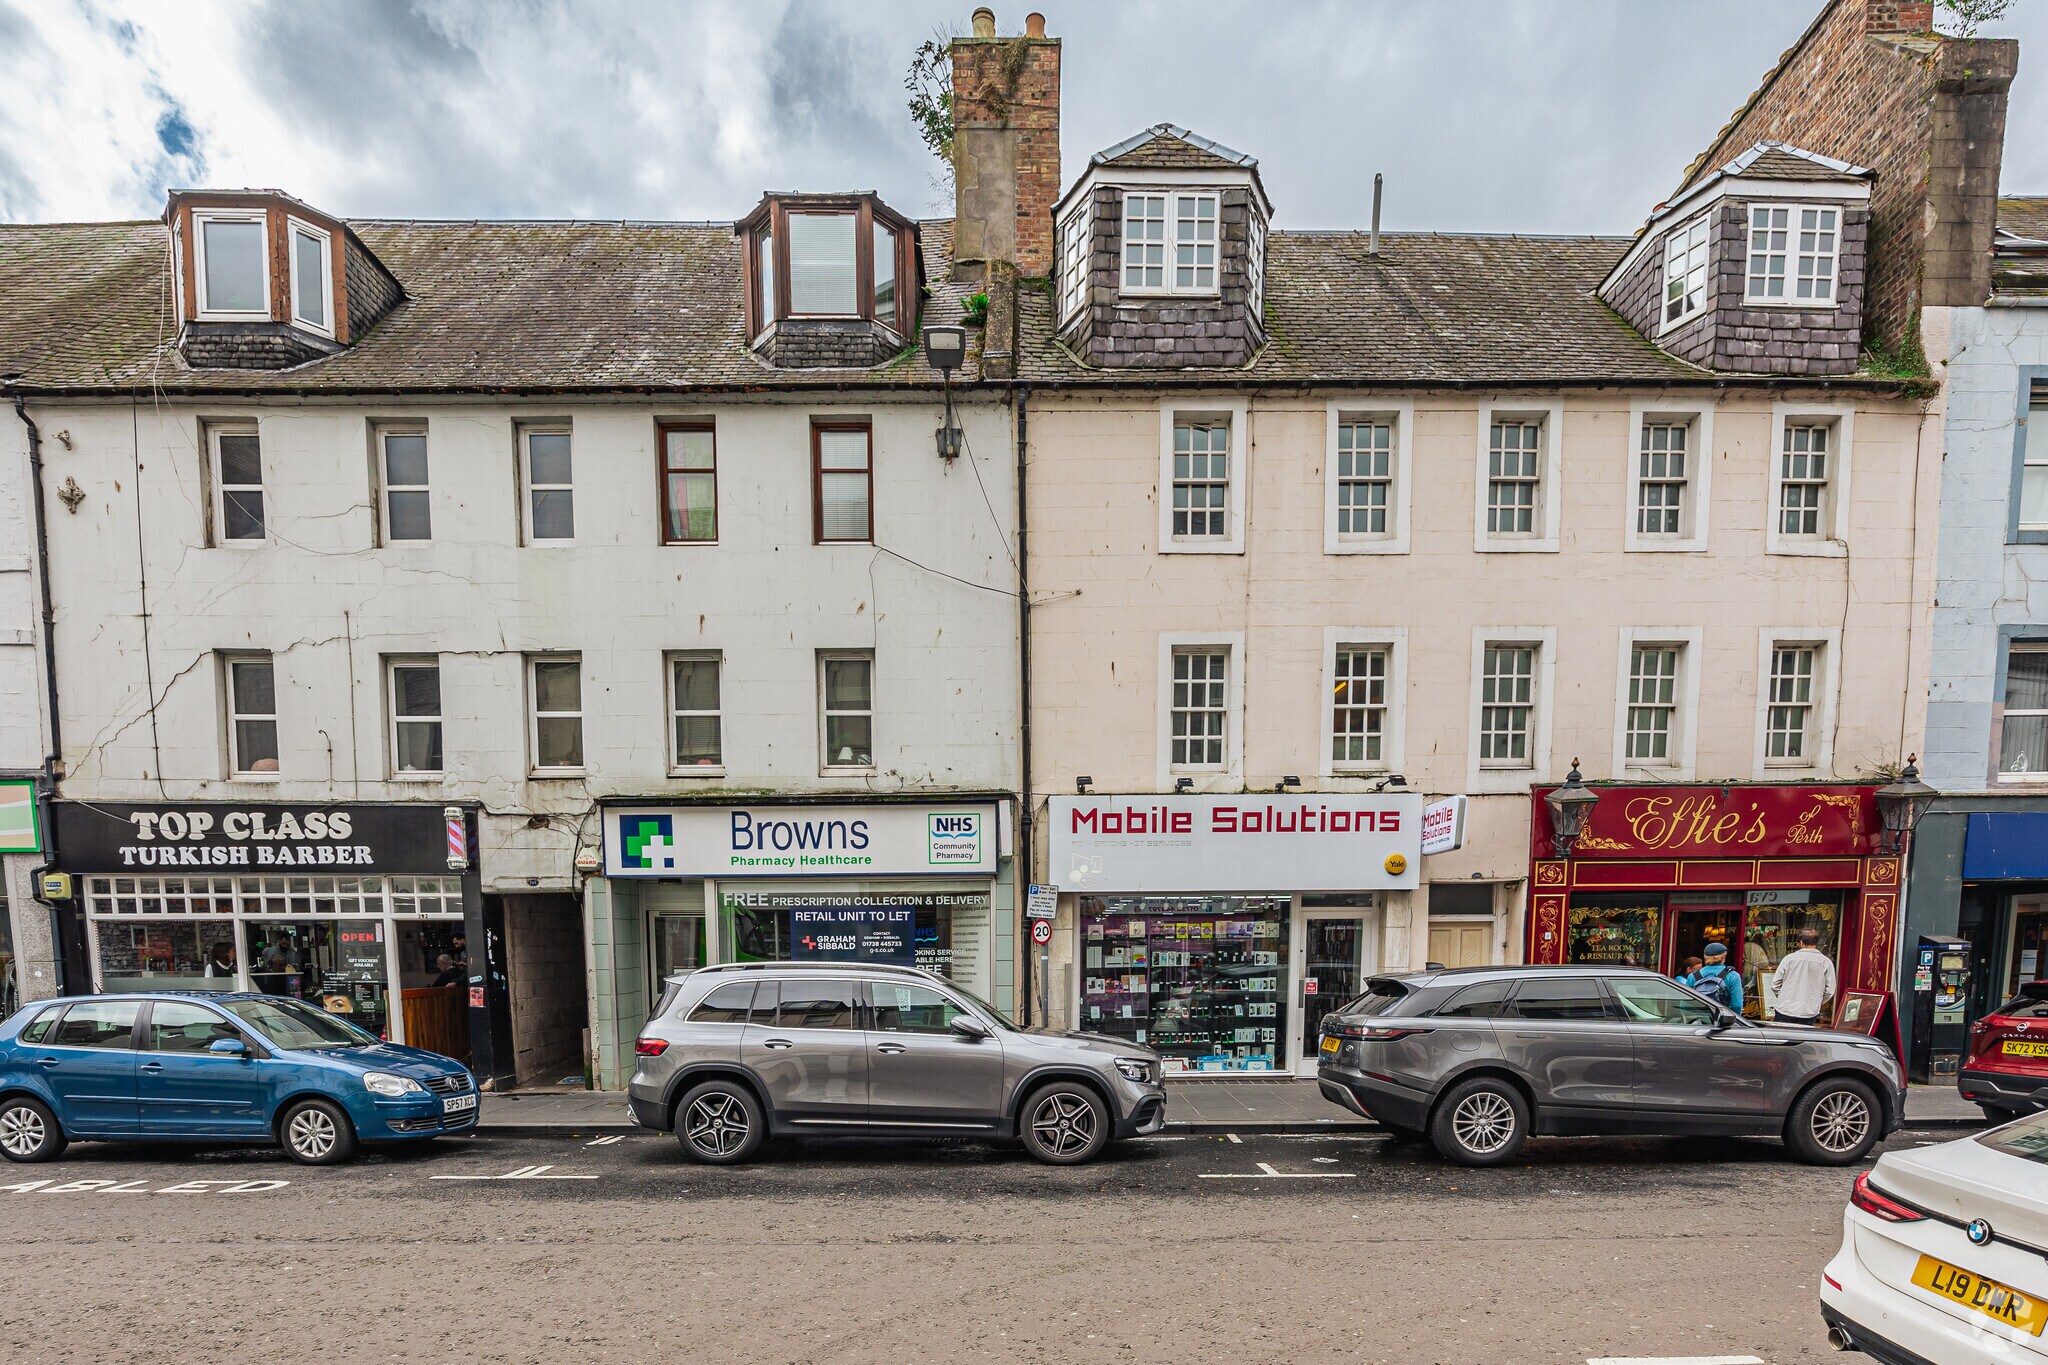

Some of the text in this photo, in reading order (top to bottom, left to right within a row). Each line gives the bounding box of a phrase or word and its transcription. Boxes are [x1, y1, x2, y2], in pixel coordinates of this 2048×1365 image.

[1072, 805, 1400, 834] Mobile Solutions
[1422, 808, 1453, 829] Mobile
[1624, 794, 1766, 849] Effie's
[1799, 804, 1822, 824] of
[130, 812, 352, 841] TOP CLASS
[731, 811, 870, 850] Browns
[936, 818, 972, 832] NHS
[1422, 825, 1451, 841] Solutions
[1785, 824, 1823, 844] Perth
[119, 845, 374, 865] TURKISH BARBER
[731, 854, 872, 868] Pharmacy Healthcare
[936, 852, 974, 860] Pharmacy
[724, 893, 988, 906] FREE PRESCRIPTION COLLECTION & DELIVERY
[796, 912, 910, 921] RETAIL UNIT TO LET
[341, 933, 374, 942] OPEN
[1036, 927, 1049, 936] 20
[2006, 1042, 2029, 1054] SK72
[447, 1099, 463, 1110] SP57
[0, 1180, 290, 1194] ABLED
[1931, 1264, 2024, 1322] L19 DWR
